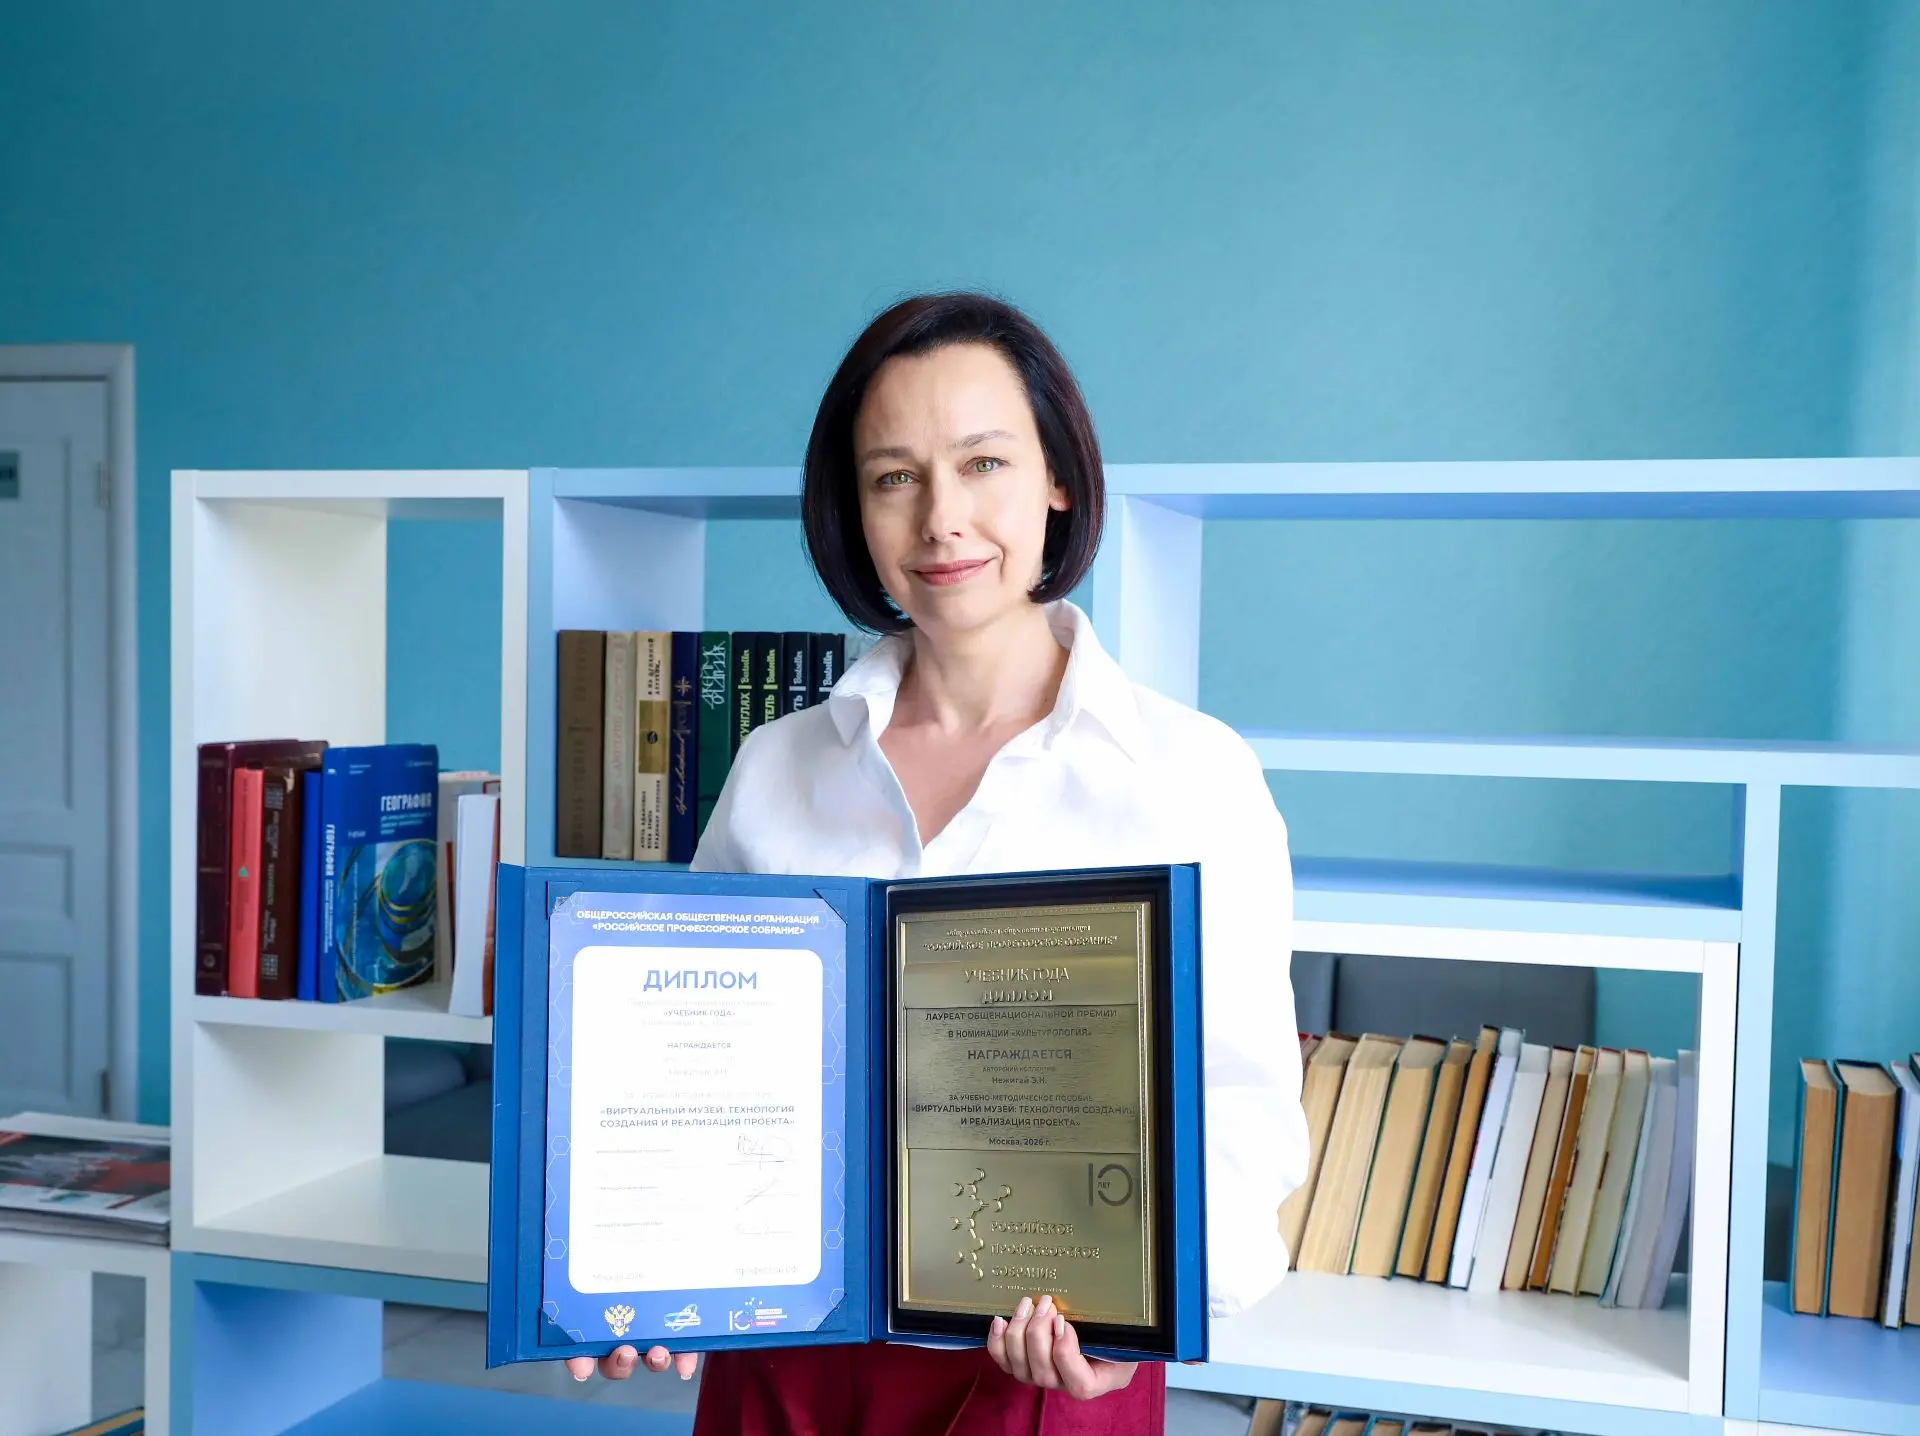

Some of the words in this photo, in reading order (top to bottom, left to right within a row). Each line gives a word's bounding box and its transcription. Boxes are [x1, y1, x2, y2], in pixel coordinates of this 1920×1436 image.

[765, 694, 775, 724] ТЕЛЬ
[381, 792, 432, 812] ГЕОГРАФИЯ
[576, 910, 673, 922] ОБЩЕРОССИЙСКАЯ
[675, 912, 752, 924] ОБЩЕСТВЕННАЯ
[753, 914, 819, 925] ОРГАНИЗАЦИЯ
[592, 921, 665, 933] «РОССИЙСКОЕ
[666, 923, 749, 934] ПРОФЕССОРСКОЕ
[751, 925, 804, 935] СОБРАНИЕ»
[643, 970, 757, 992] ДИПЛОМ
[964, 967, 1029, 983] УЧЕБНИК
[1033, 967, 1069, 982] ГОДА
[981, 990, 1054, 1004] ДИПЛОМ
[926, 1012, 965, 1021] ЛАУРЕАТ
[968, 1010, 1074, 1020] ОБЩЕНАЦИОНАЛЬНОЙ
[1076, 1009, 1117, 1018] ПРЕМИИ
[948, 1030, 954, 1038] В
[956, 1029, 1009, 1038] НОМИНАЦИИ
[968, 1049, 1072, 1060] НАГРАЖДАЕТСЯ
[961, 1094, 1054, 1102] УЧЕБНО-МЕТОДИЧЕСКОЕ
[600, 1105, 685, 1115] «ВИРТУАЛЬНЫЙ
[728, 1105, 795, 1114] ТЕХНОЛОГИЯ
[911, 1103, 982, 1113] «ВИРТУАЛЬНЫЙ
[984, 1103, 1017, 1113] МУЗЕЙ:
[1019, 1105, 1080, 1114] ТЕХНОЛОГИЯ
[600, 1119, 658, 1128] СОЗДАНИЯ
[661, 1119, 669, 1127] И
[671, 1118, 741, 1128] РЕАЛИЗАЦИЯ
[744, 1117, 795, 1126] ПРОЕКТА»
[969, 1117, 1031, 1127] РЕАЛИЗАЦИЯ
[1033, 1118, 1081, 1127] ПРОЕКТА»
[989, 1138, 1022, 1146] Москва,
[1024, 1138, 1043, 1146] 2026
[990, 1219, 1074, 1236] РОССИЙСКОЕ
[990, 1243, 1100, 1259] ПРОФЕССОРСКОЕ
[991, 1266, 1057, 1280] СОБРАНИЕ
